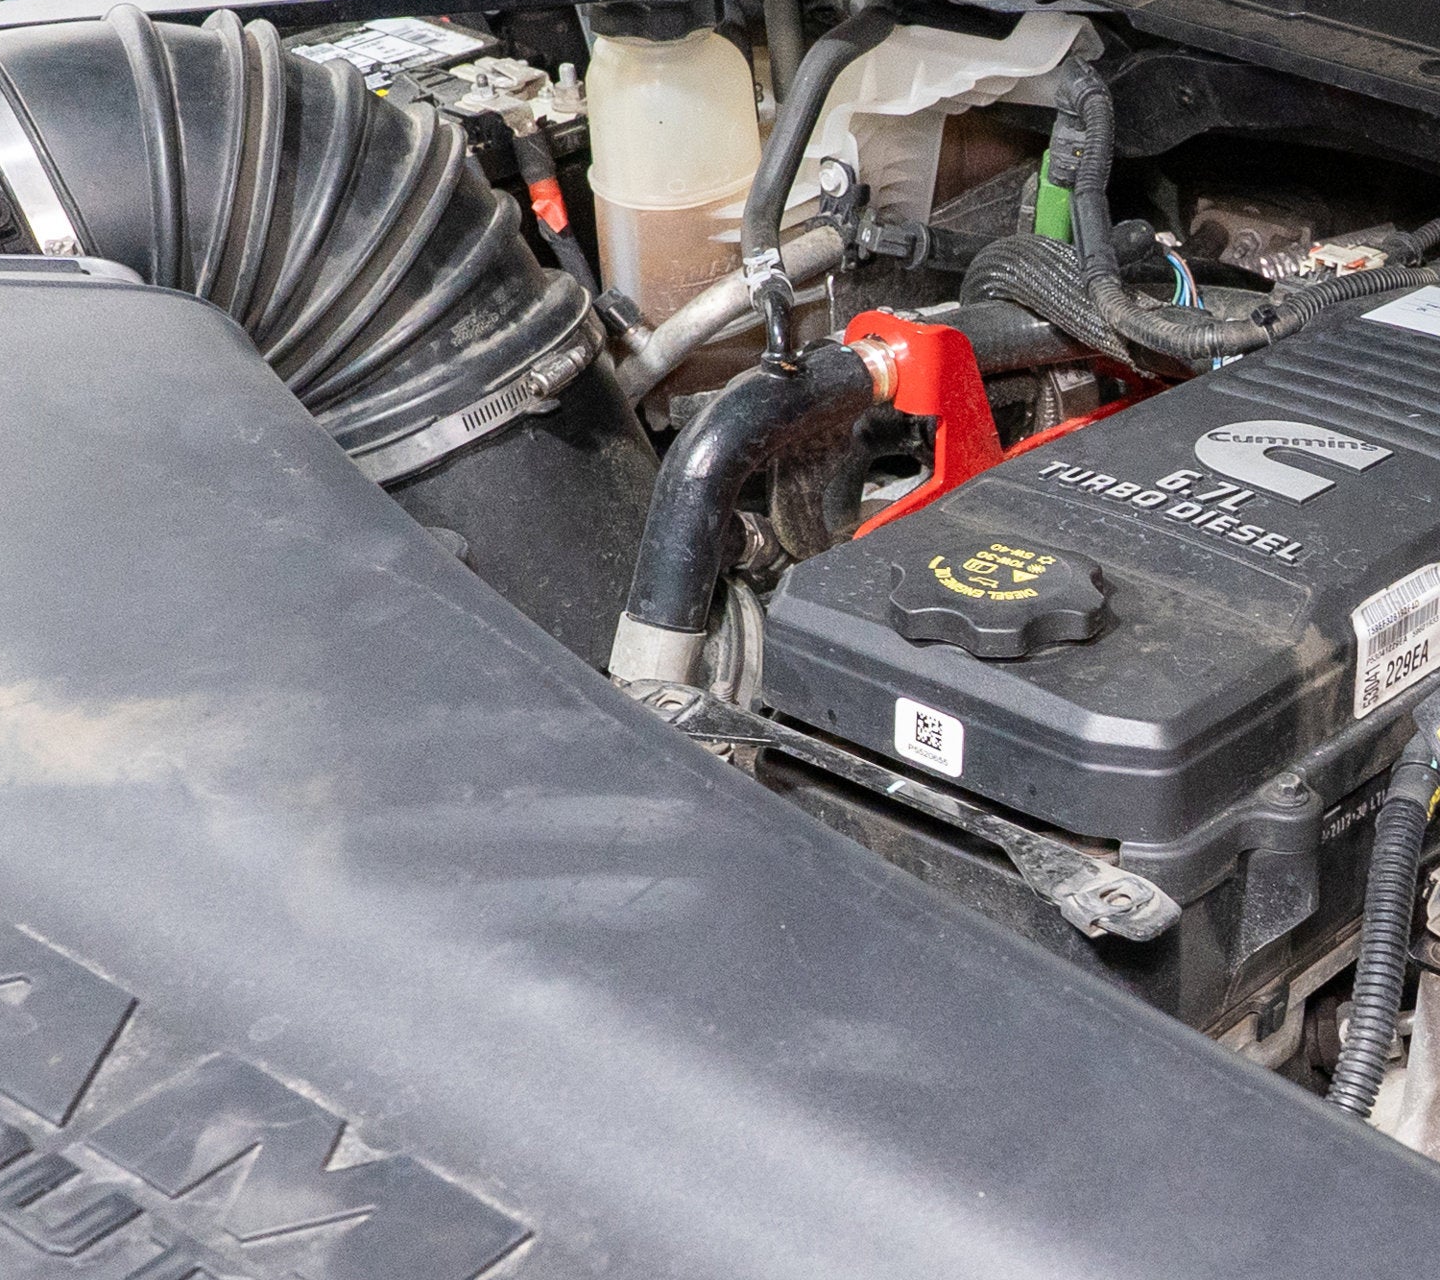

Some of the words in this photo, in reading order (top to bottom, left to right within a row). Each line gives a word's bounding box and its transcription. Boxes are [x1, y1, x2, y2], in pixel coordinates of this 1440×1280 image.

[1209, 431, 1378, 452] Cummins
[1039, 461, 1168, 510] TURBO
[1163, 501, 1305, 563] DIESEL
[1155, 469, 1256, 513] 6.7L
[990, 543, 1035, 560] 5W-40
[987, 588, 1039, 600] DIESEL
[1363, 663, 1380, 709] 53041
[1386, 639, 1429, 689] 229EA
